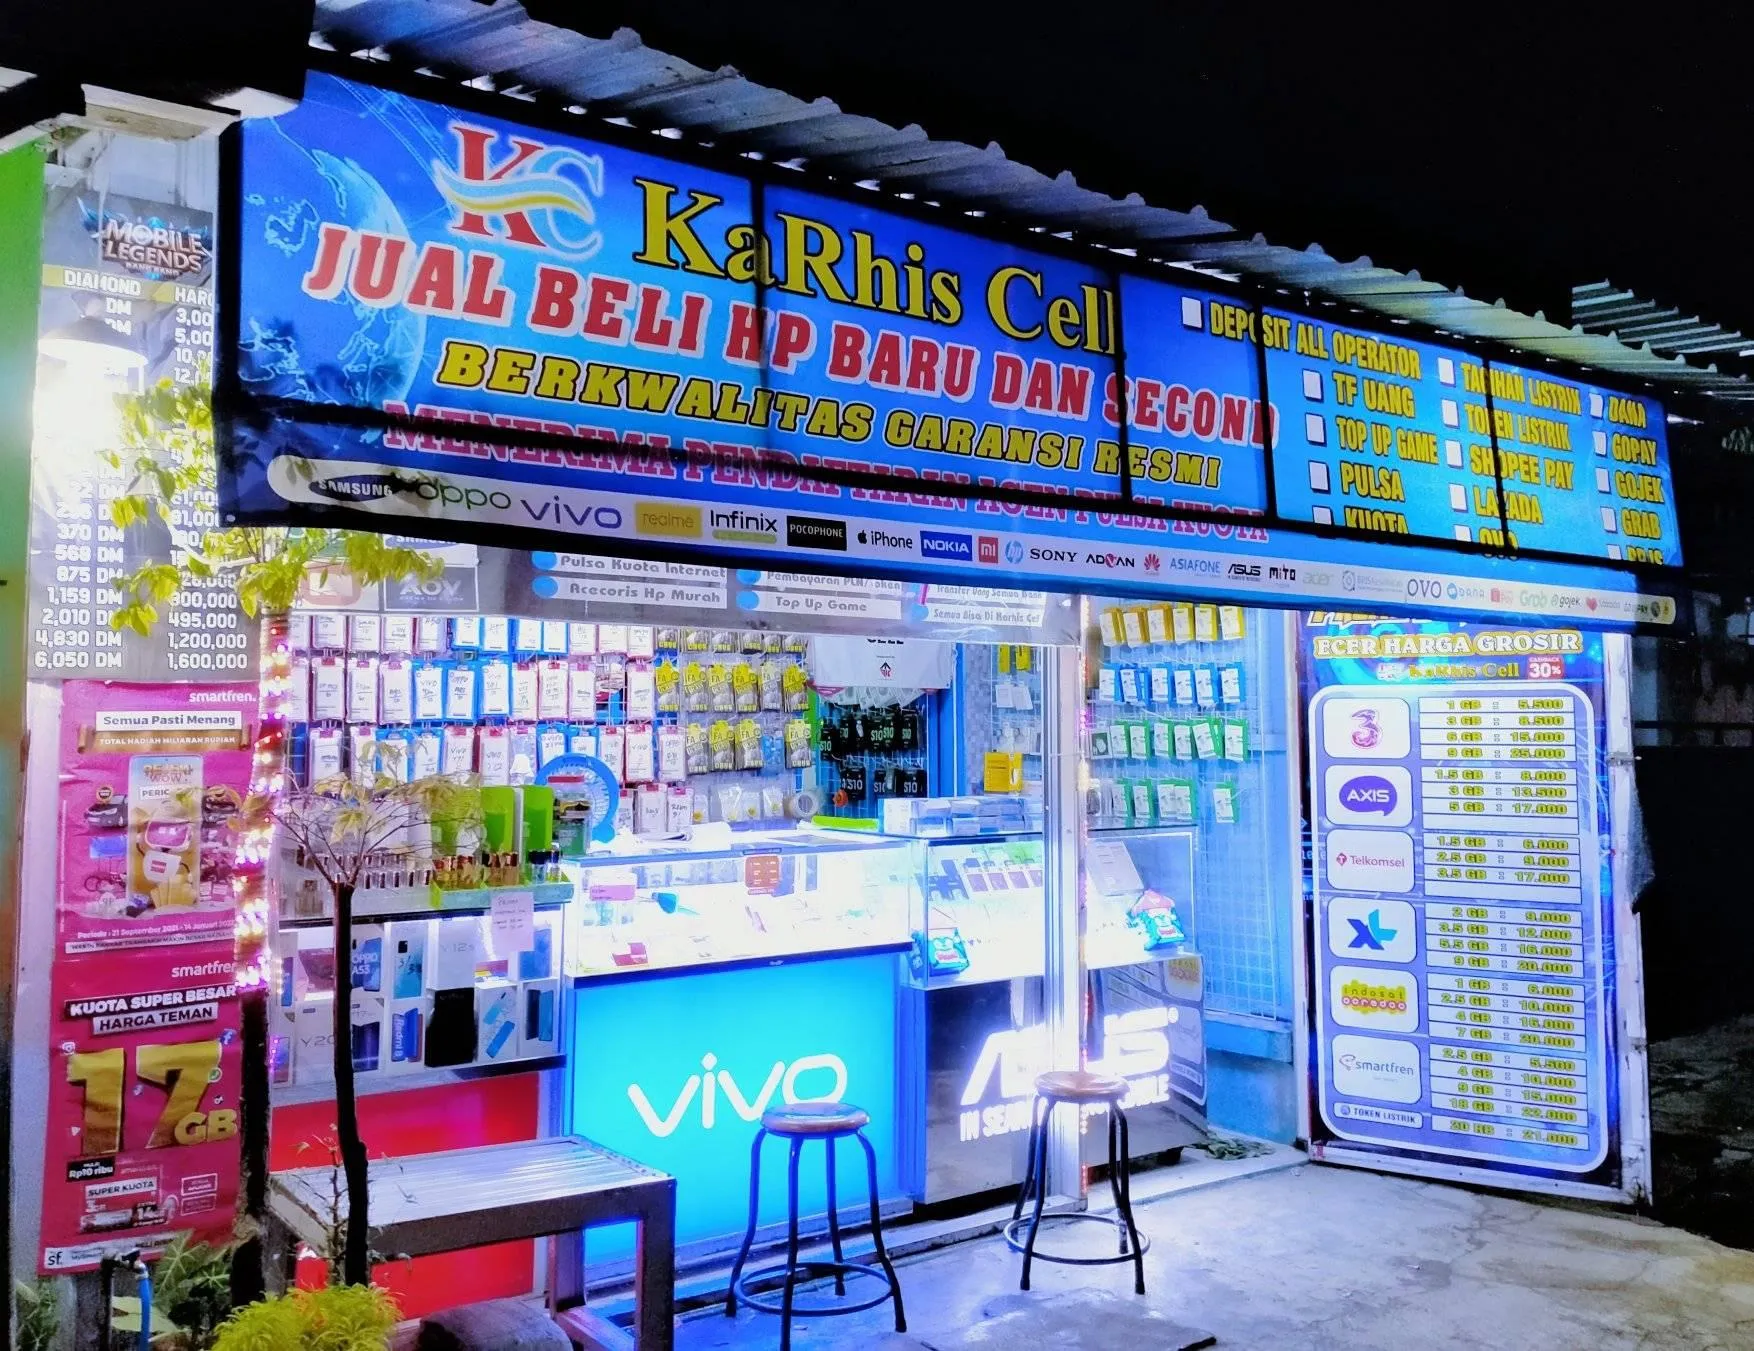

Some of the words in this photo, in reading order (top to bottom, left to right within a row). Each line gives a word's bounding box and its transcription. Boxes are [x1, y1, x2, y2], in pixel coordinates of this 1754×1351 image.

[450, 124, 604, 260] KC
[105, 219, 201, 254] MOBILE
[104, 240, 202, 273] LEGENDS
[633, 177, 961, 326] KaRhis
[986, 266, 1116, 354] Cell
[63, 270, 142, 296] DIAMOND
[106, 298, 132, 315] DM
[303, 222, 511, 327] JUAL
[527, 262, 711, 366] BELI
[722, 298, 816, 375] HP
[828, 319, 981, 403] BARU
[989, 349, 1095, 423] DAN
[1105, 371, 1281, 446] SECOND
[1296, 323, 1329, 361] ALL
[1333, 331, 1422, 380] OPERATOR
[1333, 372, 1359, 402] TF
[1363, 377, 1416, 419] UANG
[1528, 375, 1582, 416] LISTRIK
[436, 341, 876, 442] BERKWALITAS
[884, 409, 1087, 472] GARANSI
[1092, 438, 1223, 489] RESMI
[1608, 396, 1647, 428] DANA
[382, 402, 677, 480] MENERIMA
[1336, 416, 1369, 453] TOP
[1371, 422, 1394, 457] UP
[1396, 429, 1440, 466] GAME
[1517, 413, 1573, 452] LISTRIK
[1612, 432, 1657, 466] GOPAY
[1340, 461, 1406, 502] PULSA
[1544, 457, 1576, 491] PAY
[1615, 469, 1665, 504] GOJEK
[1473, 486, 1544, 525] LAADA
[1621, 508, 1661, 540] GRAB
[98, 526, 125, 543] DM
[316, 476, 394, 498] SAMSUNG
[520, 494, 623, 529] vivo
[642, 510, 695, 529] realme
[709, 509, 779, 533] Infinix
[788, 523, 844, 539] POCOPHONE
[869, 531, 914, 550] iPhone
[923, 538, 970, 555] NOKIA
[1030, 547, 1078, 563] SONY
[1085, 552, 1136, 568] ADVAN
[1169, 556, 1222, 574] ASIAFONE
[1227, 563, 1262, 577] ASUS
[1303, 571, 1333, 585] acer
[1407, 578, 1442, 598] OVO
[1559, 595, 1581, 608] gojek
[97, 547, 124, 563] DM
[56, 566, 91, 583] 875
[561, 554, 606, 570] Pulsa
[611, 558, 660, 573] Kuota
[665, 562, 727, 578] Internet
[47, 586, 91, 605] 1,159
[96, 588, 123, 604] DM
[644, 588, 666, 602] Hp
[671, 589, 721, 603] Murah
[775, 596, 800, 610] Top
[805, 598, 823, 611] Up
[827, 599, 868, 612] Game
[42, 609, 91, 626] 2,010
[168, 612, 237, 630] 495,000
[34, 630, 90, 648] 4,830
[95, 631, 122, 647] DM
[167, 632, 247, 650] 1,200,000
[1316, 637, 1378, 656] ECER
[1383, 636, 1471, 655] HARGA
[1476, 632, 1581, 652] GROSIR
[34, 652, 89, 669] 6,050
[95, 652, 122, 668] DM
[167, 653, 248, 670] 1,600,000
[1482, 662, 1520, 677] Cell
[1529, 664, 1562, 678] 30%
[1460, 700, 1481, 710] GB
[1518, 700, 1563, 709] 5.500
[103, 716, 149, 725] Semua
[151, 714, 184, 725] Pasti
[186, 715, 236, 726] Menang
[1461, 716, 1482, 725] GB
[1519, 716, 1564, 725] 8.500
[1461, 732, 1482, 741] GB
[1510, 732, 1565, 742] 15.000
[1461, 748, 1483, 757] GB
[1435, 769, 1458, 779] 1.5
[1462, 770, 1483, 779] GB
[1521, 771, 1566, 781] 8.000
[1346, 788, 1391, 803] AXIS
[1449, 786, 1459, 795] 3
[1463, 786, 1484, 796] GB
[1512, 787, 1567, 797] 13.500
[1449, 802, 1459, 812] 5
[1463, 802, 1485, 813] GB
[1512, 803, 1567, 814] 17.000
[1437, 836, 1460, 846] 1.5
[1464, 837, 1486, 847] GB
[1350, 855, 1405, 868] Telkomsel
[1437, 852, 1461, 862] 2.5
[1465, 853, 1487, 863] GB
[1438, 868, 1461, 878] 3.5
[1466, 869, 1487, 880] GB
[1515, 872, 1570, 883] 17.000
[1452, 907, 1462, 917] 2
[1467, 908, 1488, 919] GB
[1346, 908, 1398, 951] XL
[70, 998, 126, 1017] KUOTA
[130, 992, 184, 1010] SUPER
[185, 984, 237, 1002] BESAR
[1342, 986, 1405, 999] indosat
[1341, 996, 1407, 1011] ooredoo
[100, 1014, 156, 1032] HARGA
[159, 1006, 212, 1023] TEMAN
[1355, 1060, 1415, 1076] smartfren
[66, 1039, 222, 1155] 17
[174, 1108, 237, 1145] GB
[628, 1053, 847, 1137] vivo
[1353, 1107, 1381, 1119] TOKEN
[1383, 1111, 1416, 1124] LISTRIK
[94, 1165, 113, 1175] ribu
[88, 1186, 120, 1196] SUPER
[122, 1181, 154, 1191] KUOTA
